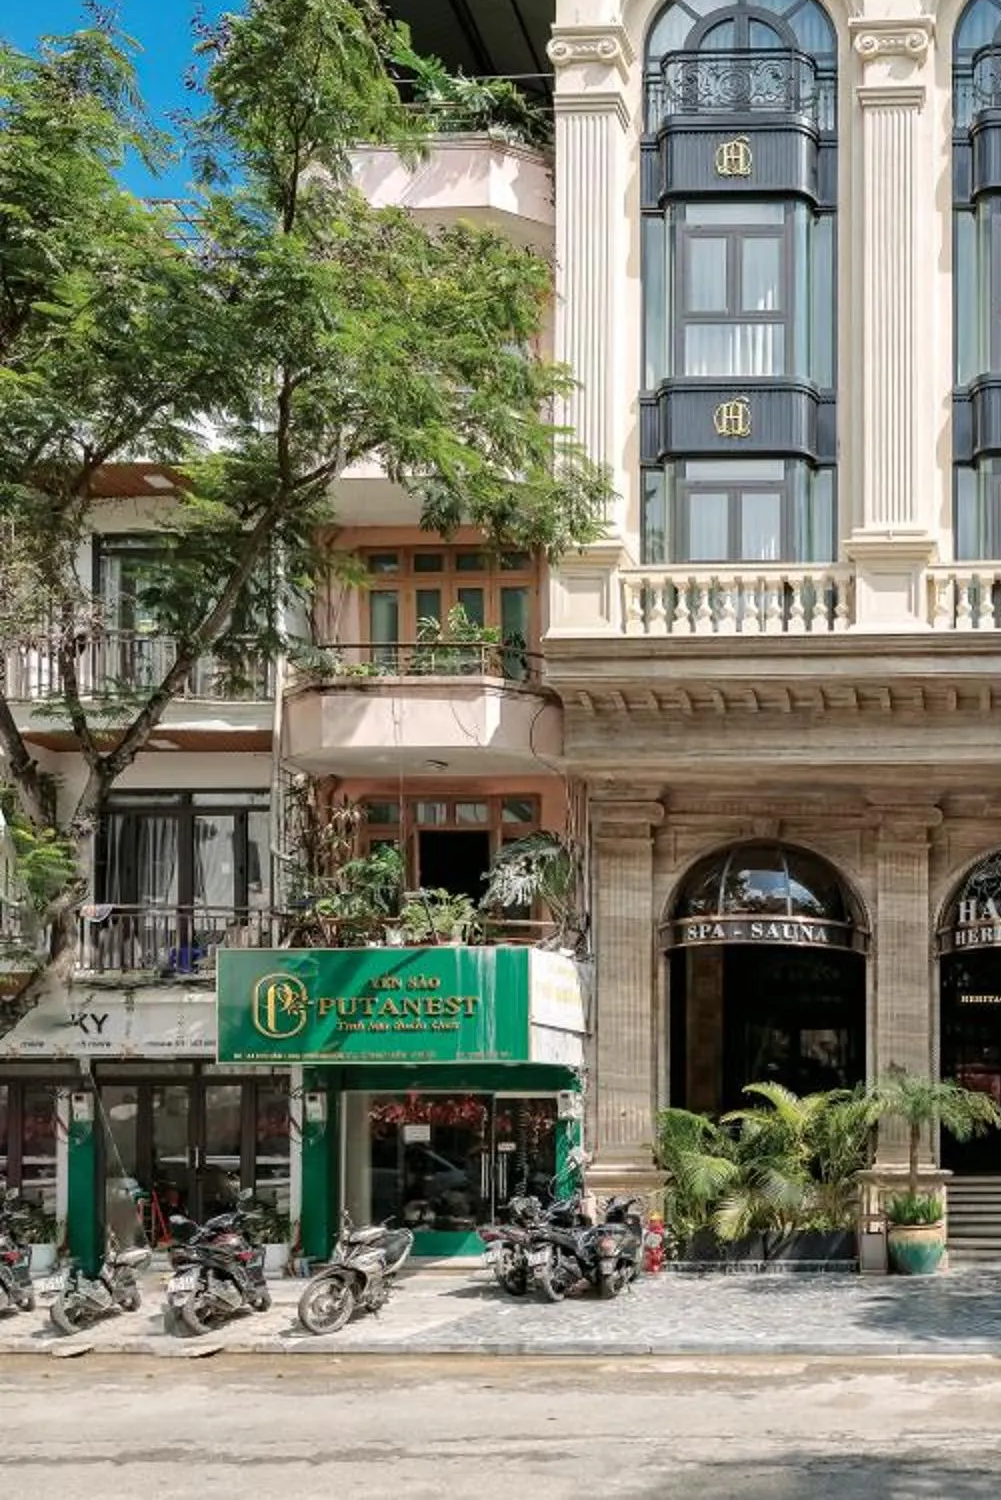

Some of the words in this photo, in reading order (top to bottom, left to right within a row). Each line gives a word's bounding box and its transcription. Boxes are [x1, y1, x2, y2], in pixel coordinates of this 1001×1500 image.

[687, 923, 725, 941] SPA
[750, 922, 829, 943] SAUNA
[318, 996, 481, 1017] PUTANEST
